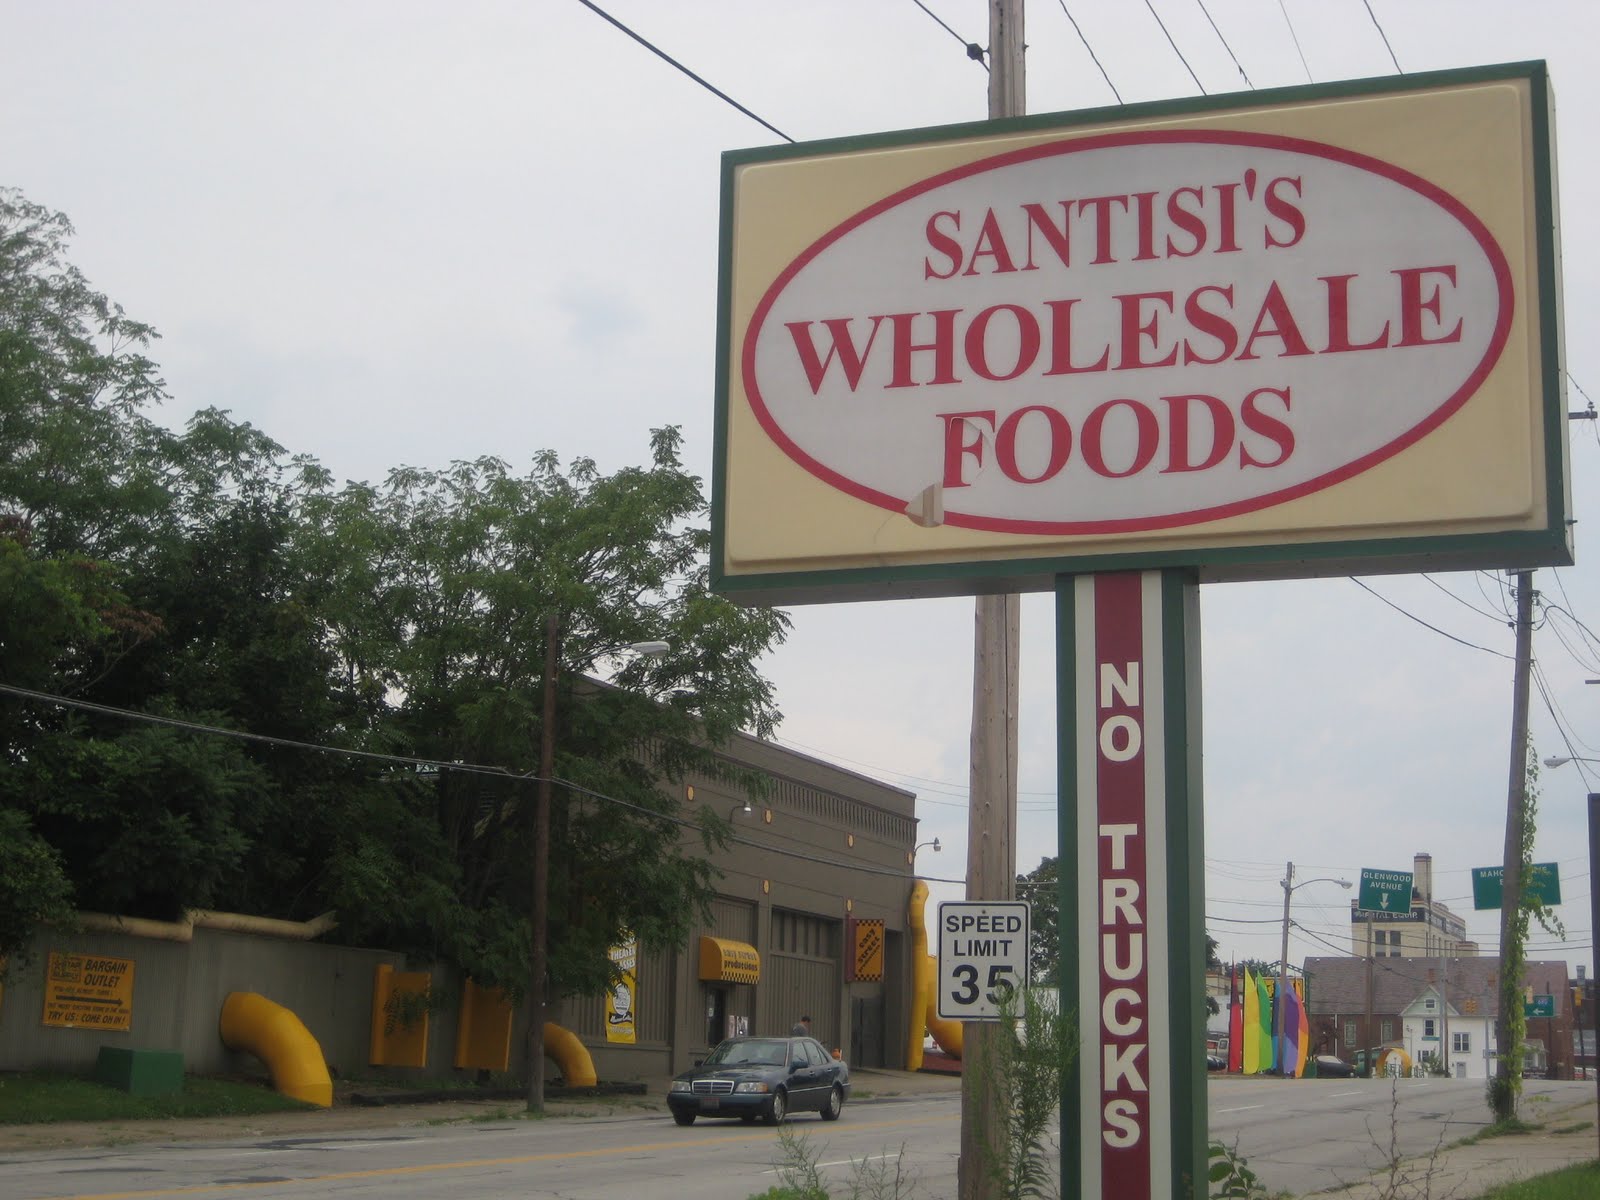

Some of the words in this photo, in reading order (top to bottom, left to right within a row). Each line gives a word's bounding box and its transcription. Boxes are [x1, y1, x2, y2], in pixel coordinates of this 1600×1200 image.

[924, 168, 1306, 280] SANTISI'S
[784, 265, 1463, 396] WHOLESALE
[935, 386, 1295, 488] FOODS
[1100, 661, 1142, 762] NO
[1363, 872, 1411, 882] GLENWOOD
[1370, 881, 1403, 891] AVENUE
[946, 915, 1021, 933] SPEED
[954, 939, 1012, 956] LIMIT
[85, 959, 128, 975] BARGAIN
[724, 960, 758, 972] productions
[84, 974, 120, 988] OUTLET
[951, 964, 1014, 1005] 35
[1099, 823, 1148, 1148] TRUCKS
[48, 1010, 63, 1021] TRY
[81, 1013, 102, 1023] COME
